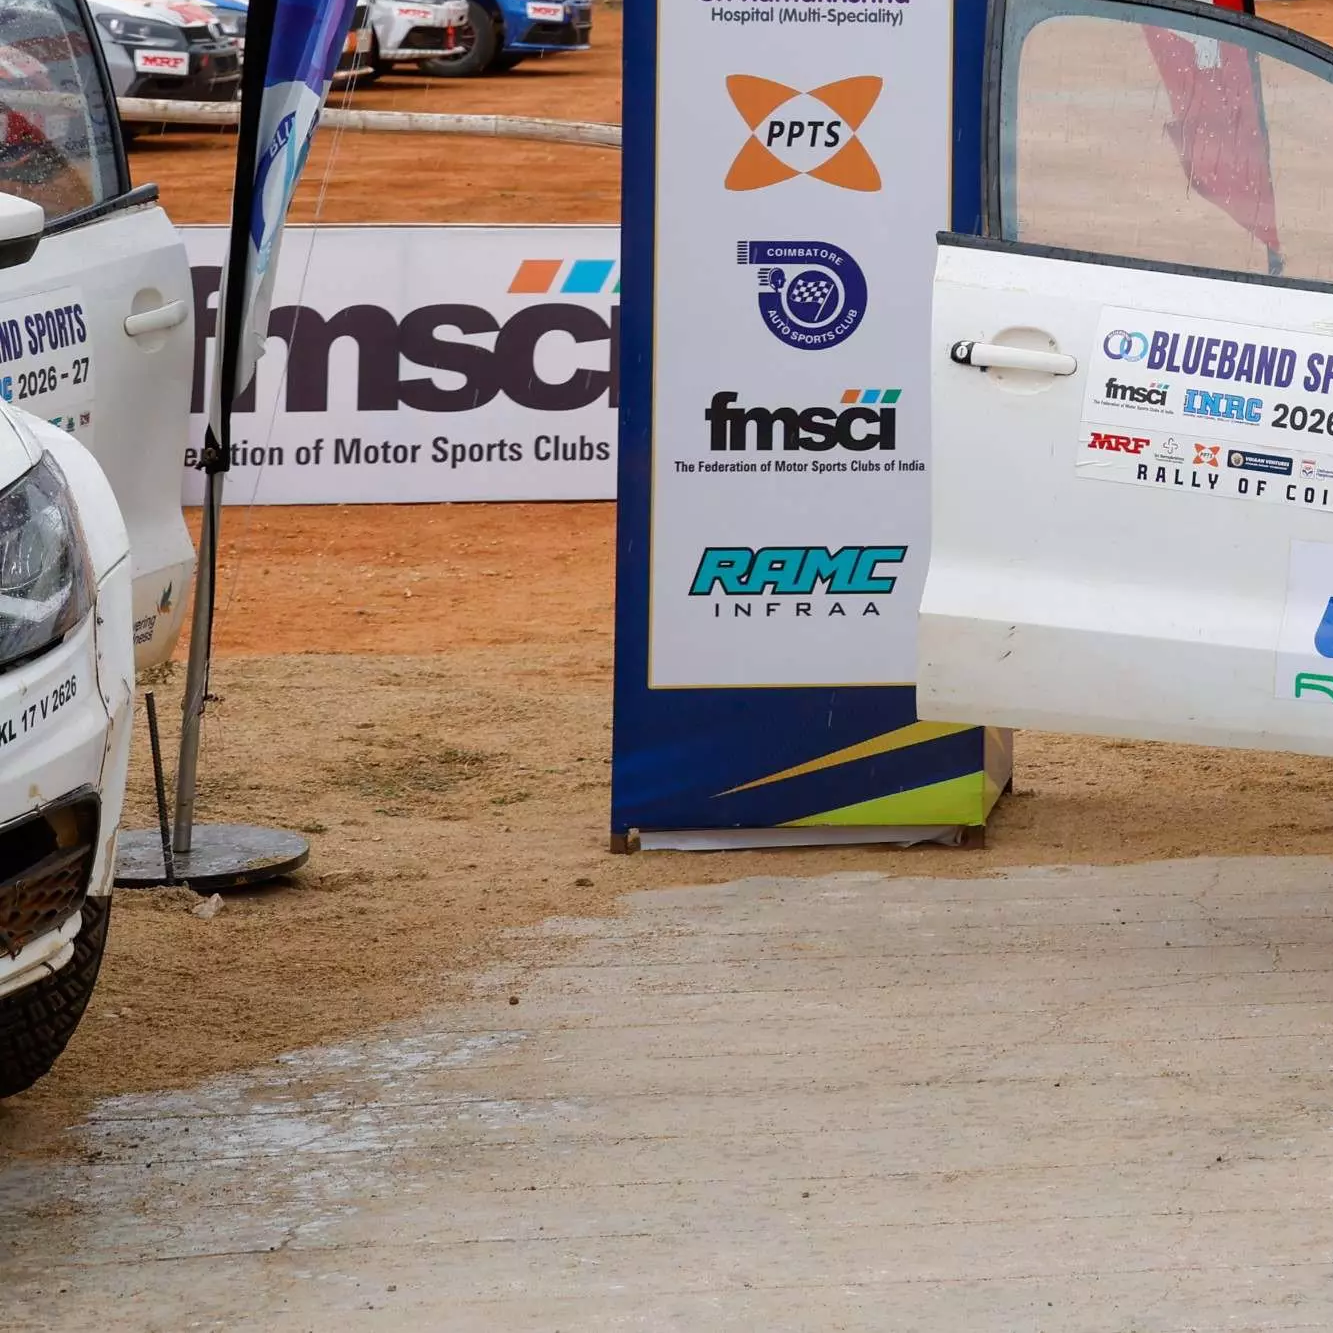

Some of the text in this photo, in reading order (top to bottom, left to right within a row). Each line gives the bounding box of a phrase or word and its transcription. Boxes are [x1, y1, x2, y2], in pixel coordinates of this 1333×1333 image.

[711, 6, 904, 28] Hospital (Multi-Speciality)
[766, 120, 842, 148] PPTS
[767, 247, 845, 267] COIMBATORE
[24, 304, 87, 356] SPORTS
[768, 308, 858, 345] AUTO SPORTS CLUB
[1147, 330, 1297, 389] BLUEBAND
[18, 366, 57, 399] 2026
[72, 357, 90, 385] 27
[1105, 378, 1167, 406] fmsci
[1184, 388, 1263, 422] INRC
[705, 391, 896, 451] fmsci
[295, 434, 611, 468] of Motor Sports Clubs
[1088, 432, 1150, 454] MRF
[675, 459, 925, 475] The Federation of Motor Sports Clubs of India
[1137, 463, 1220, 490] RALLY
[1238, 478, 1268, 497] OF
[688, 545, 908, 596] RAMC
[715, 602, 881, 618] INFRAA
[0, 674, 77, 745] KL 17 V 2626
